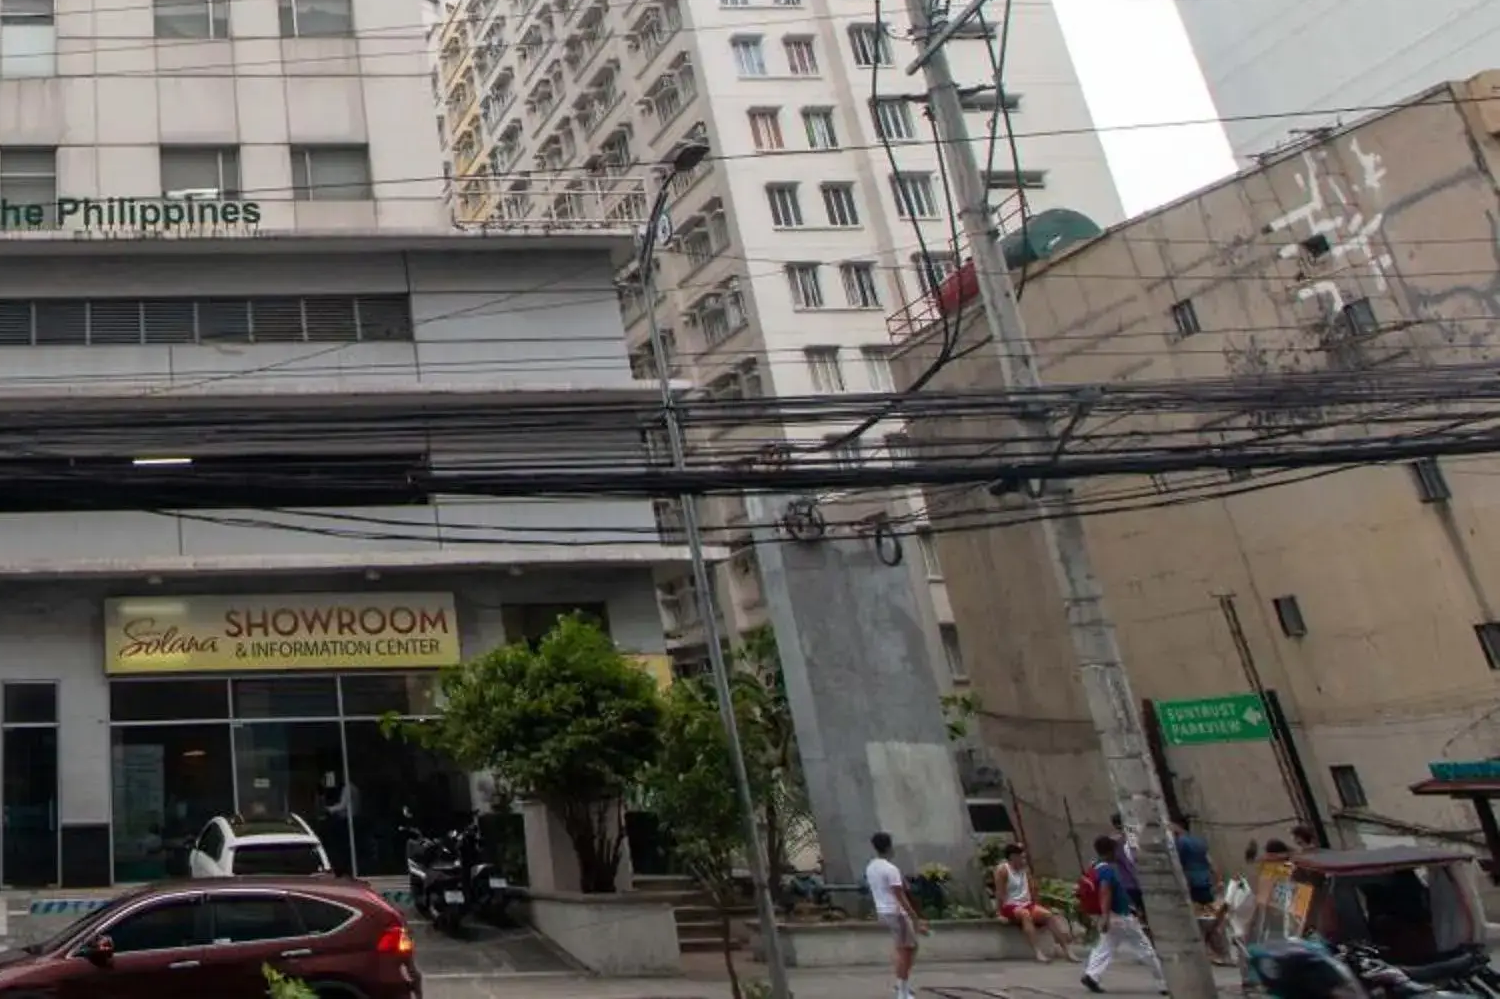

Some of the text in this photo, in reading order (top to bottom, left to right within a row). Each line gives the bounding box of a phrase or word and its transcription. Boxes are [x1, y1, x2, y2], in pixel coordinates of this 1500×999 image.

[58, 197, 261, 232] Philippines
[117, 616, 220, 659] Solana
[225, 606, 449, 638] SHOWROOM
[235, 638, 440, 659] & INFORMATION CENTER
